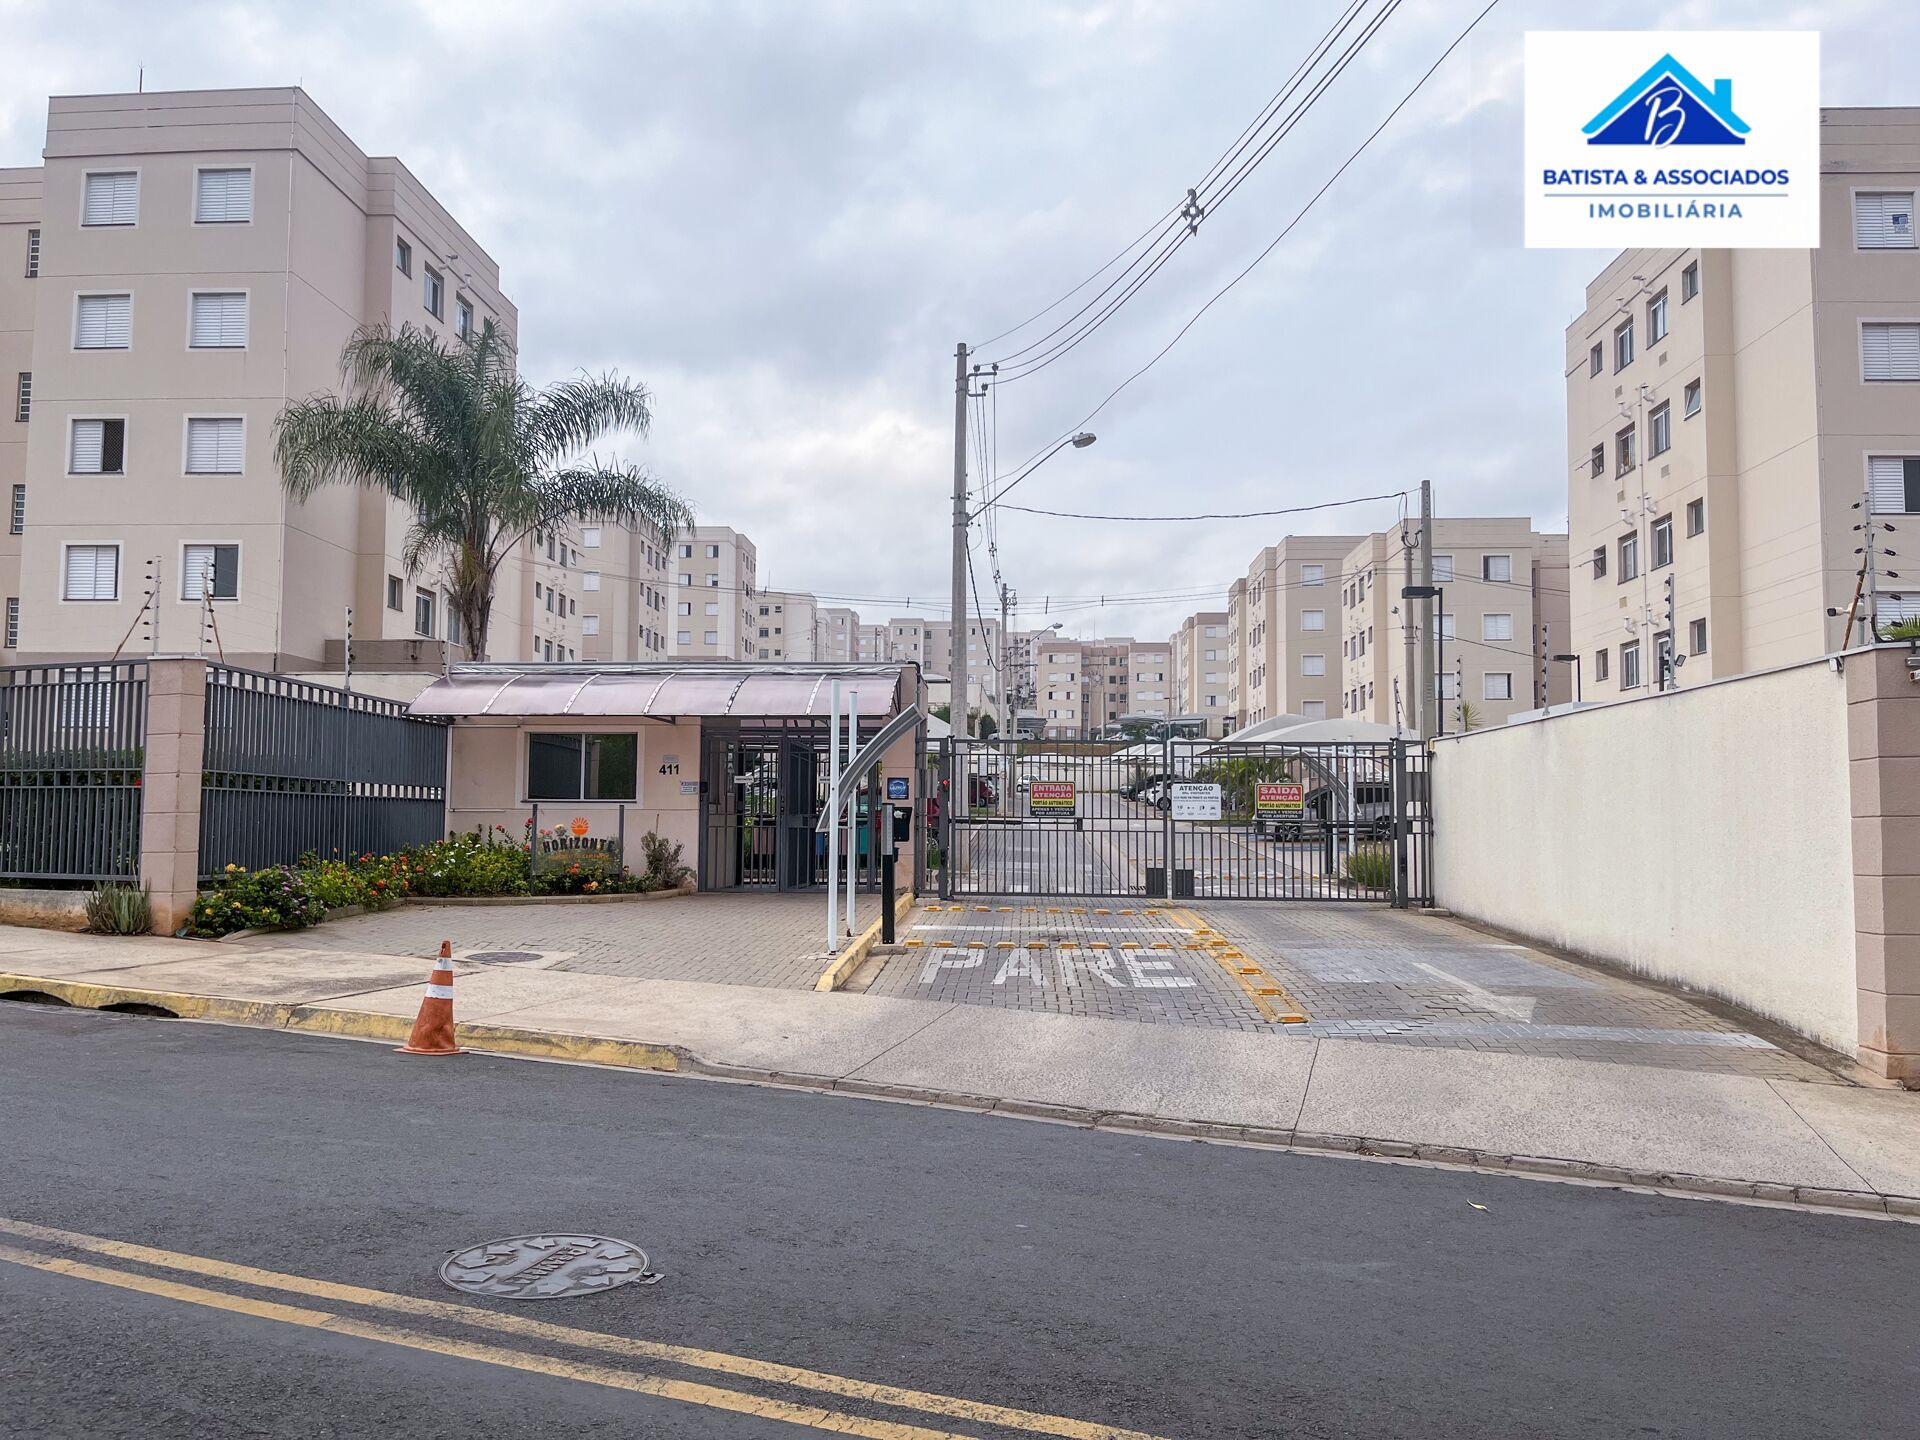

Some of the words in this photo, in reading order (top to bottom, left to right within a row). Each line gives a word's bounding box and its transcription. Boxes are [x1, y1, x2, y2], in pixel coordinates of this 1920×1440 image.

[659, 764, 679, 775] 411
[543, 837, 615, 853] HORIZONTE
[918, 948, 1197, 988] PARE
